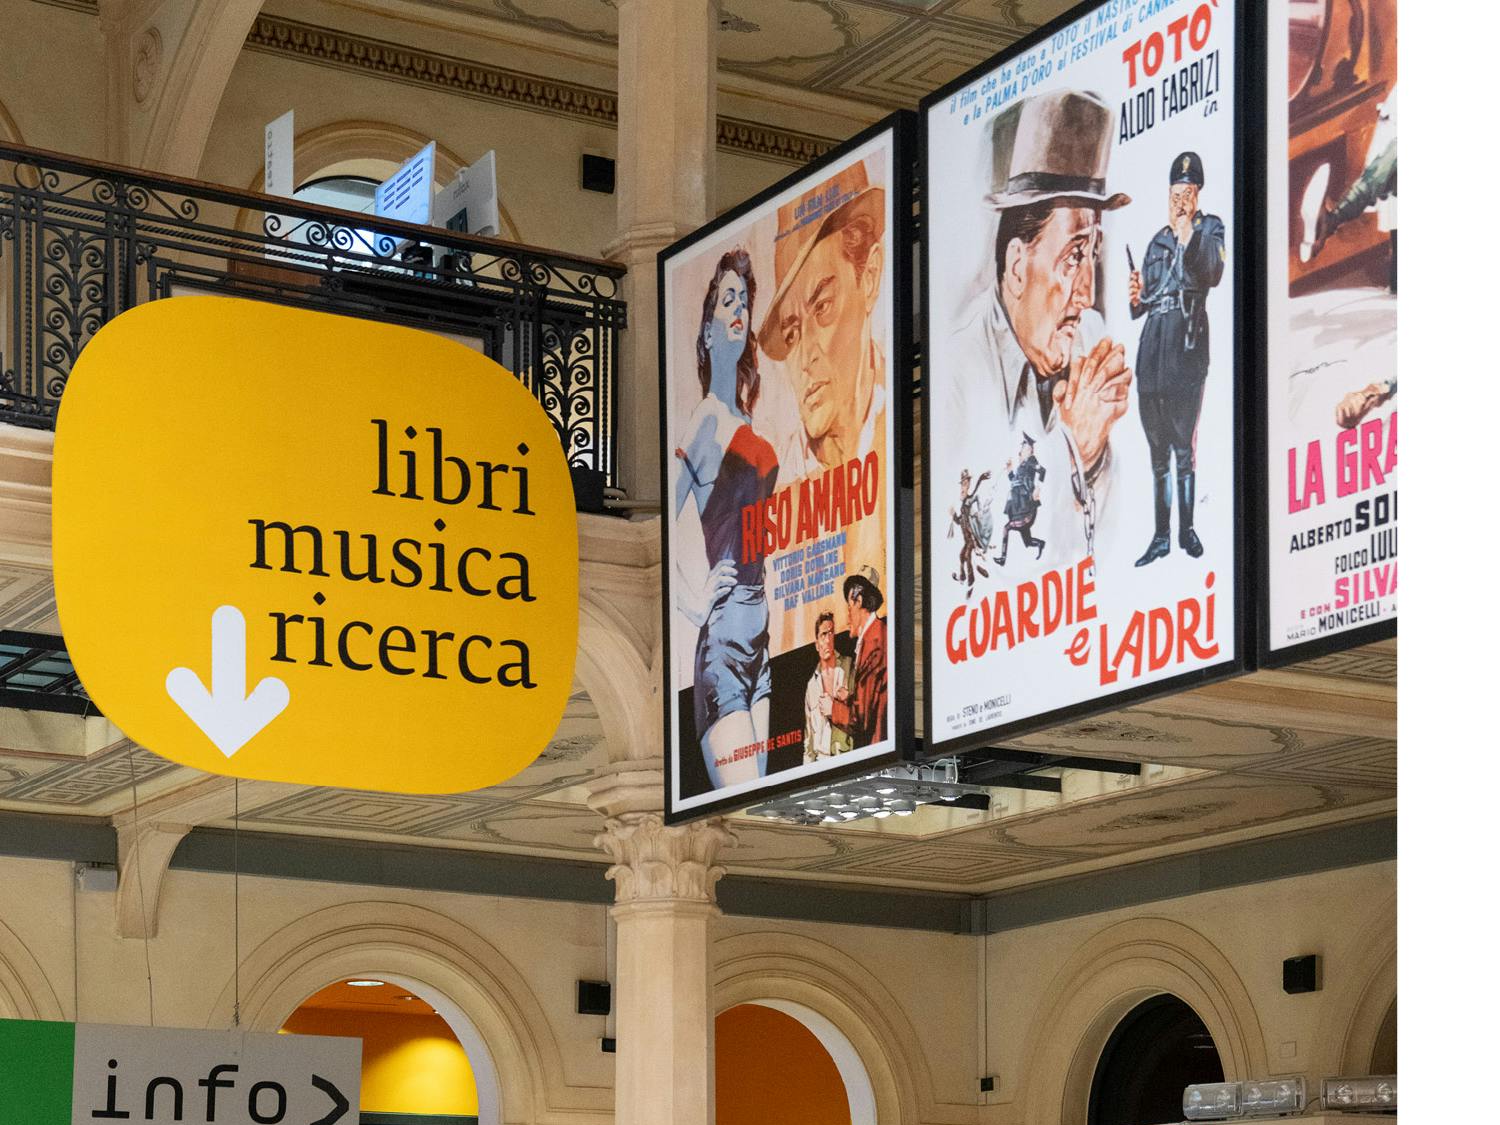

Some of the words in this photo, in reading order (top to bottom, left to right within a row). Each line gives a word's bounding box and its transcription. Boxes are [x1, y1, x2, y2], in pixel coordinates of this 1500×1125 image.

[960, 88, 977, 108] film
[981, 78, 998, 96] che
[1016, 54, 1036, 75] dato
[985, 81, 1018, 112] PALMA
[1021, 60, 1052, 91] D'ORO
[1070, 22, 1117, 63] FESTIVAL
[1119, 87, 1154, 145] ALDO
[1162, 49, 1220, 121] FABRIZI
[1204, 99, 1219, 118] in
[371, 419, 536, 516] libri
[1288, 439, 1326, 514] LA
[742, 486, 791, 565] RISO
[796, 450, 878, 544] AMARO
[1289, 517, 1352, 554] ALBERTO
[1355, 491, 1397, 533] SO
[248, 518, 537, 603] musica
[773, 548, 804, 572] VITTORIO
[1335, 548, 1368, 575] FOLCO
[1370, 527, 1397, 564] LUL
[774, 577, 805, 600] SILVANA
[946, 555, 1097, 665] GUARDIE
[1286, 626, 1317, 641] MARIO
[1318, 601, 1380, 634] MONICELLI
[1309, 603, 1331, 617] CON
[269, 591, 538, 689] ricerca
[1064, 627, 1091, 667] e
[1099, 571, 1220, 687] LADRI
[733, 740, 765, 762] GIUSEPPE
[776, 729, 802, 748] SANTIS
[92, 1059, 288, 1125] info
